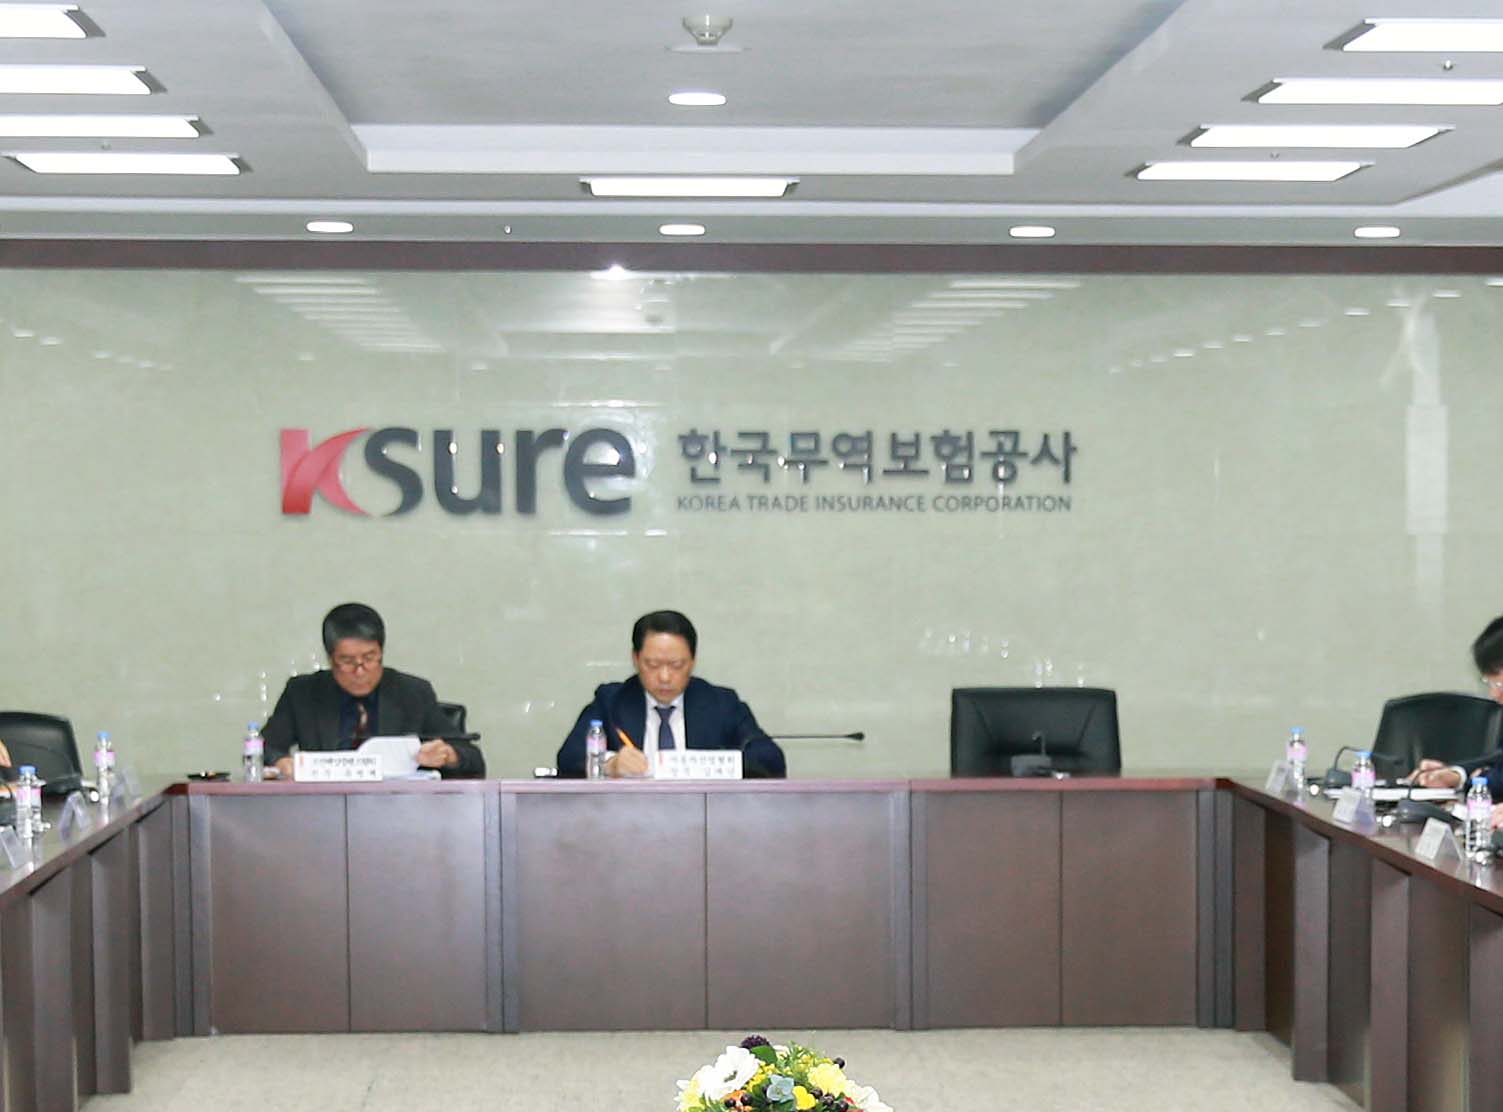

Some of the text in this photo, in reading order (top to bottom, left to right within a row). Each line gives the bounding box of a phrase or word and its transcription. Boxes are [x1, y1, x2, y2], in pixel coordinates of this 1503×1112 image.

[677, 429, 1077, 485] 한국무역보험공사
[677, 495, 1072, 513] KOREA TRADE INSURANCE CORPORATION
